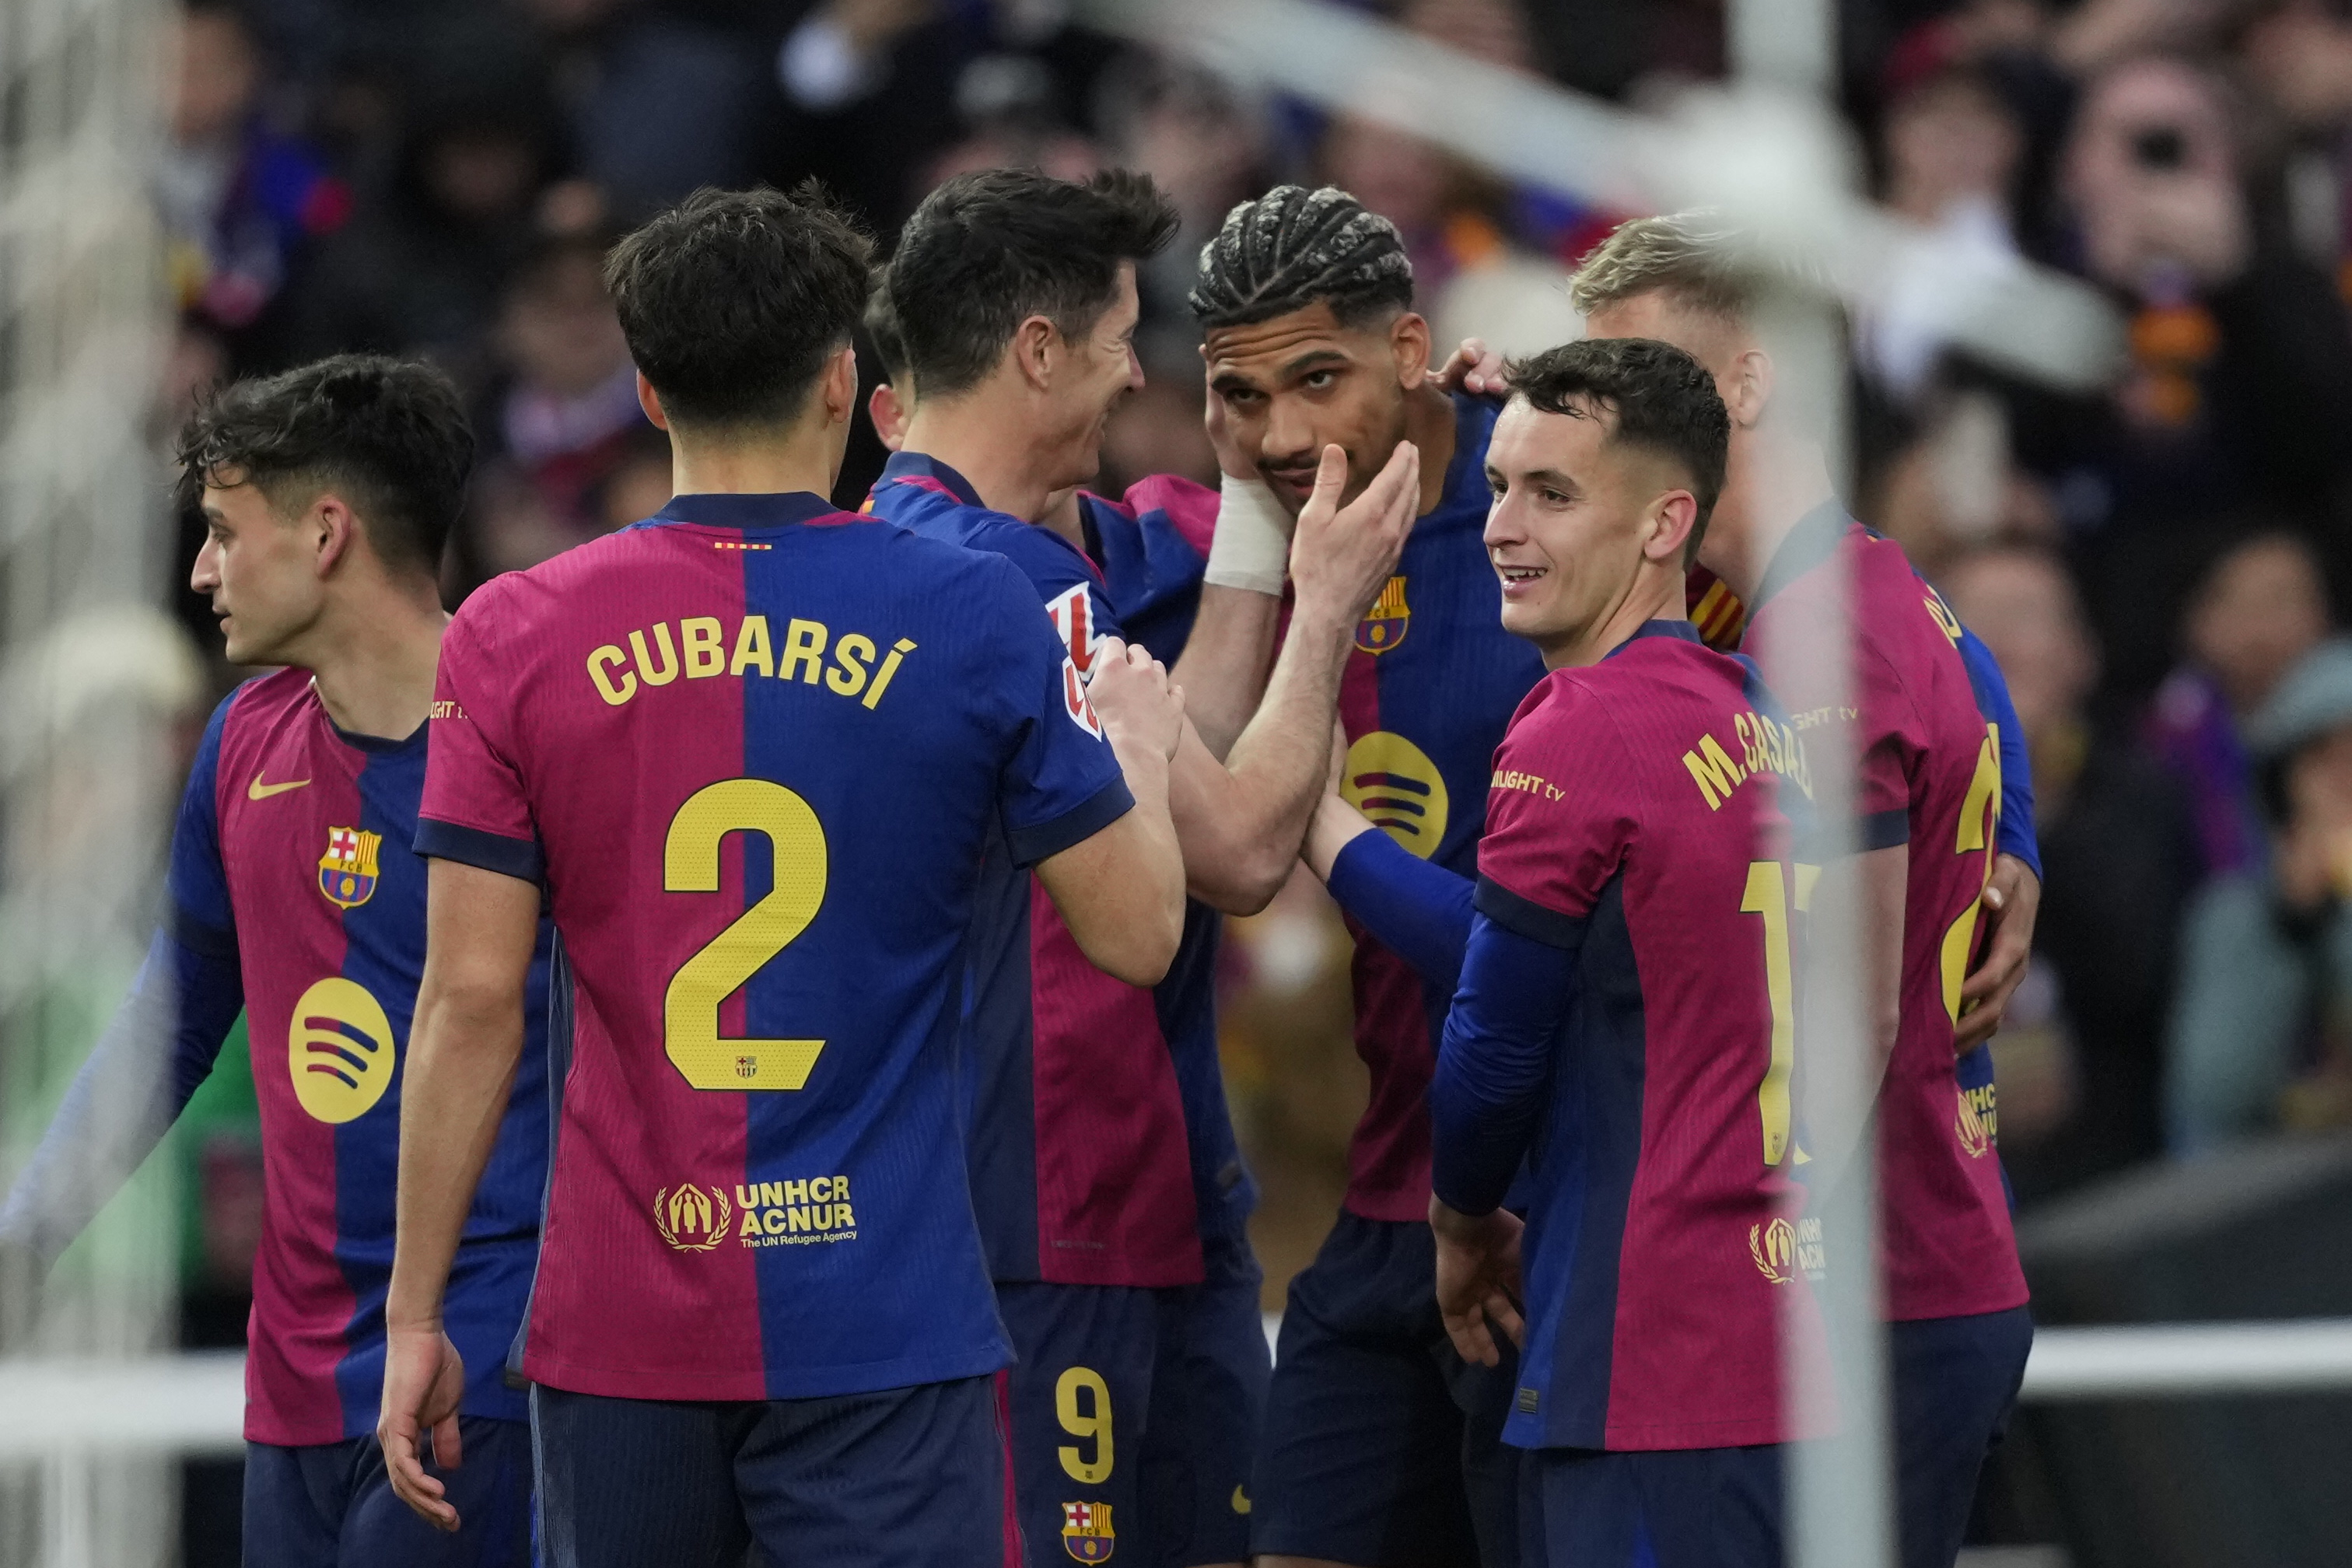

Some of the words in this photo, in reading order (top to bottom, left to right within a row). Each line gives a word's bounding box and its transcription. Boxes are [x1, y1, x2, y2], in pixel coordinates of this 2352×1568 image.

[586, 614, 919, 711] CUBARSÍ
[1545, 782, 1566, 802] tv
[340, 859, 363, 873] FCB
[663, 778, 828, 1090] 2
[735, 1175, 851, 1209] UNHCR
[738, 1202, 856, 1237] ACNUR
[740, 1238, 761, 1248] The
[762, 1236, 779, 1247] UN
[779, 1234, 821, 1245] Refugee
[823, 1230, 857, 1243] Agency
[1055, 1366, 1115, 1485] 9
[1080, 1527, 1101, 1536] FCB
